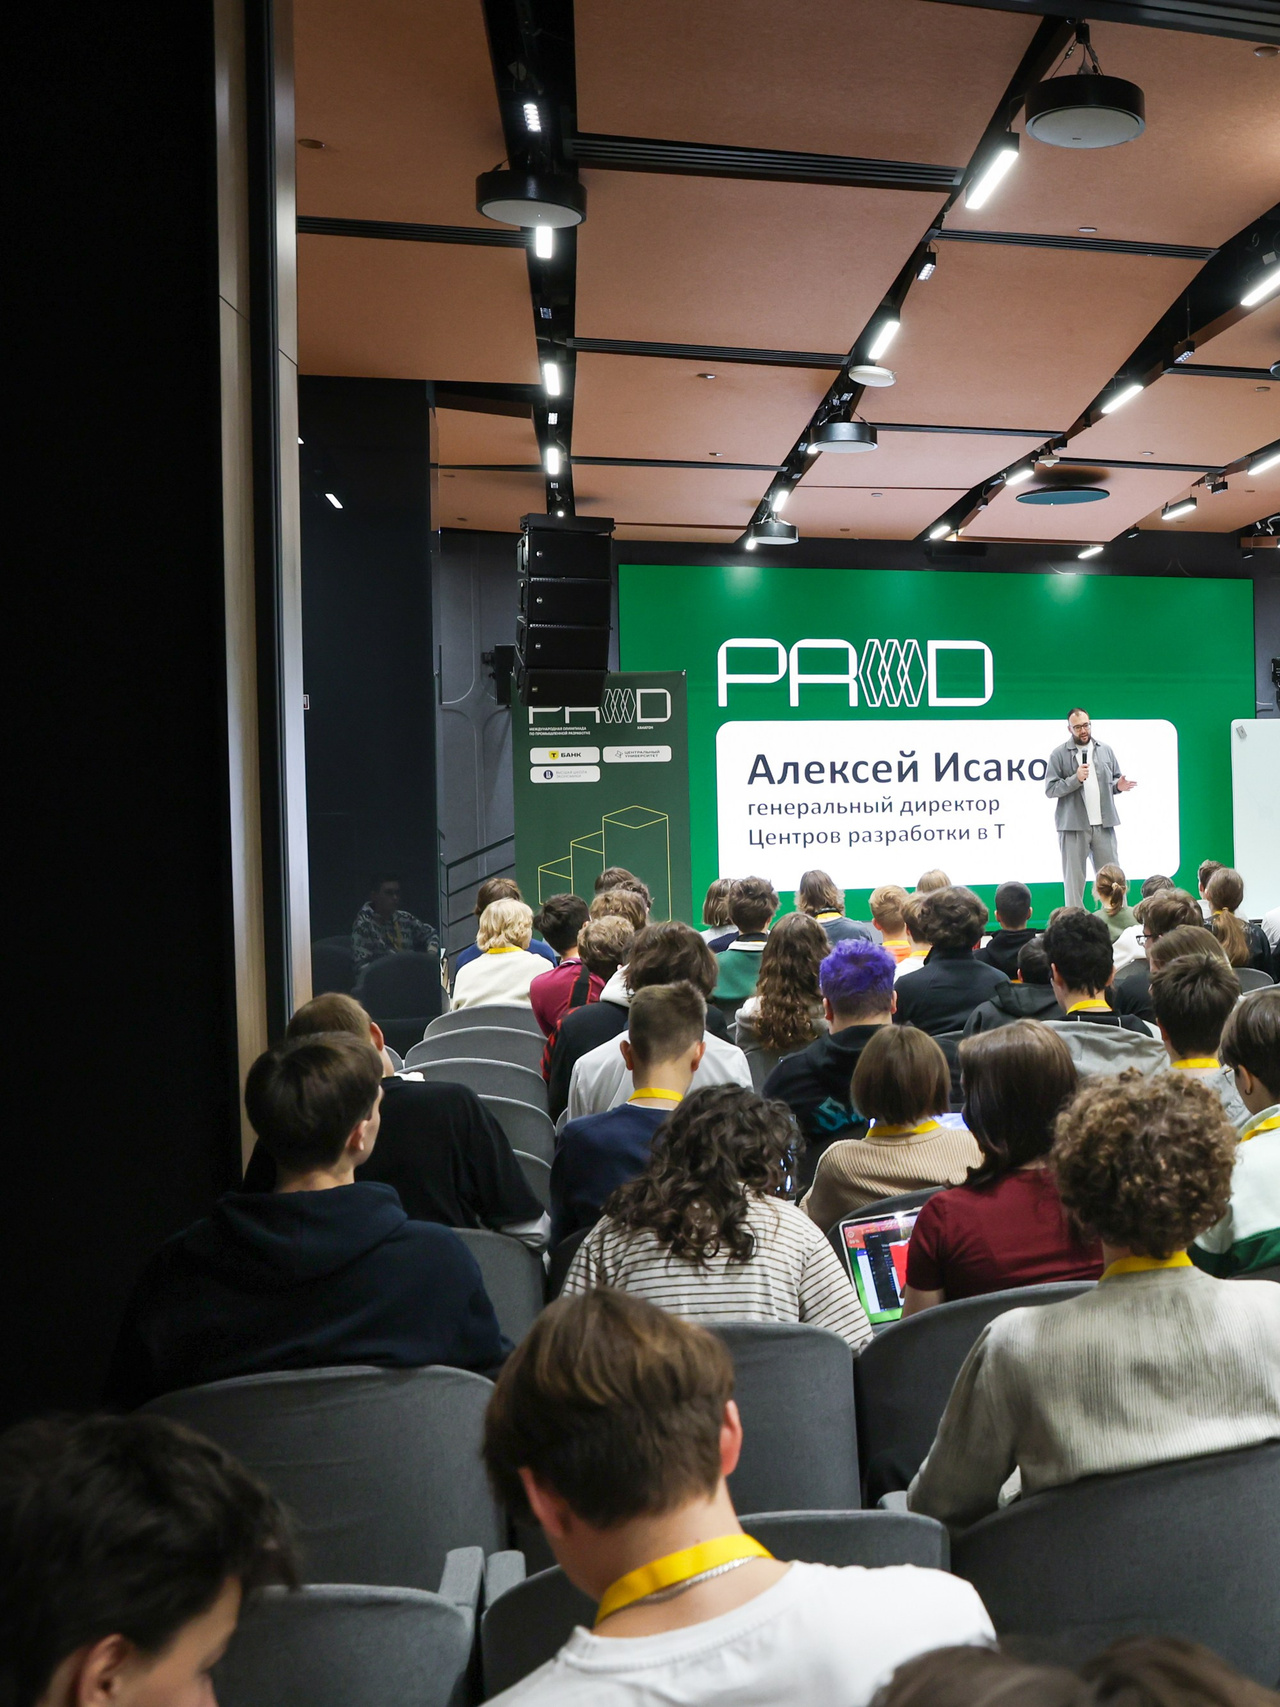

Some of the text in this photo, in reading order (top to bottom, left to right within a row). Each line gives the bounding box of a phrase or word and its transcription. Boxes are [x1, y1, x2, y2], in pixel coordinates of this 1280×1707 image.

[747, 750, 1048, 785] Алексей Исако
[748, 796, 1000, 819] генеральный директор
[748, 828, 841, 848] Центров
[849, 825, 970, 846] разработки
[977, 826, 988, 840] в
